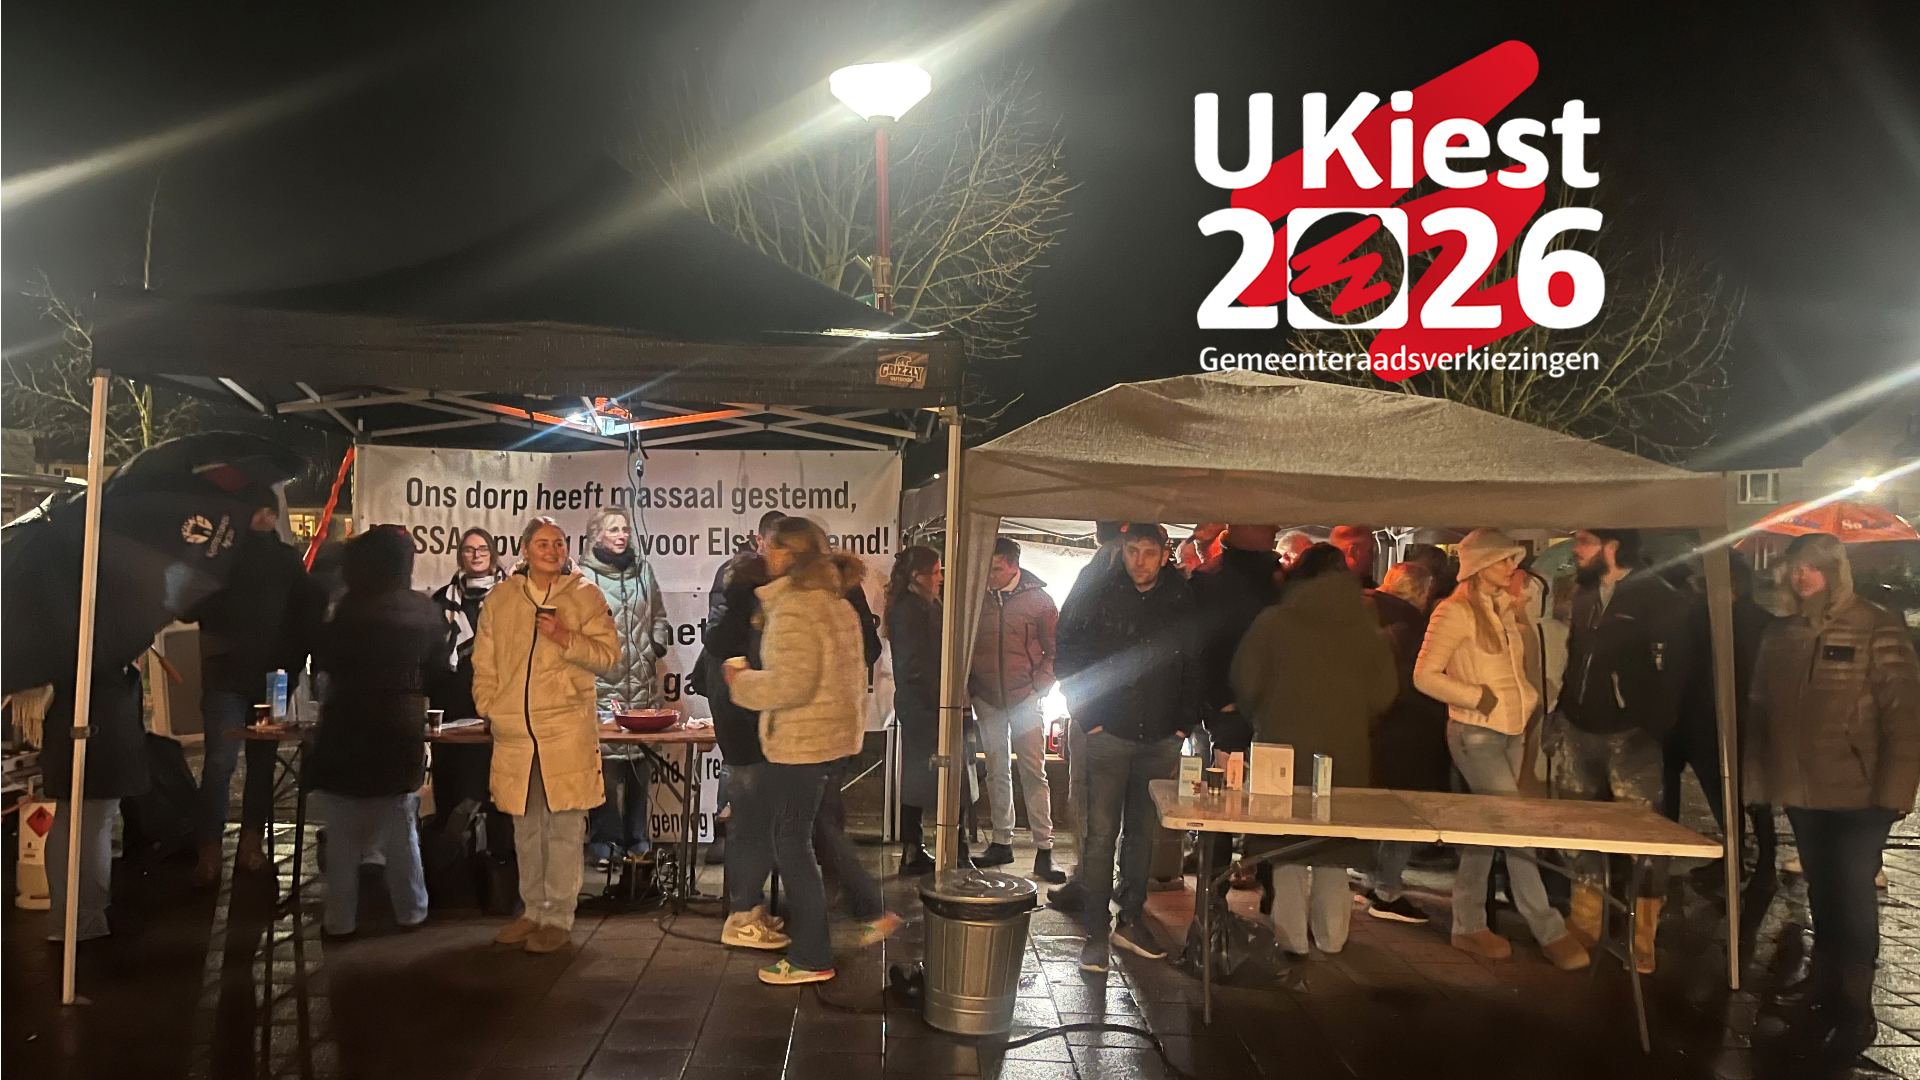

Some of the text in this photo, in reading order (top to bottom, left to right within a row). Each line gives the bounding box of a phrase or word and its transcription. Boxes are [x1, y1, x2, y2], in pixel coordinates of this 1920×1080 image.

[880, 363, 924, 381] GRIZZLY
[406, 477, 857, 516] Ons dorp heeft massaal gestemd,
[640, 531, 700, 556] voor
